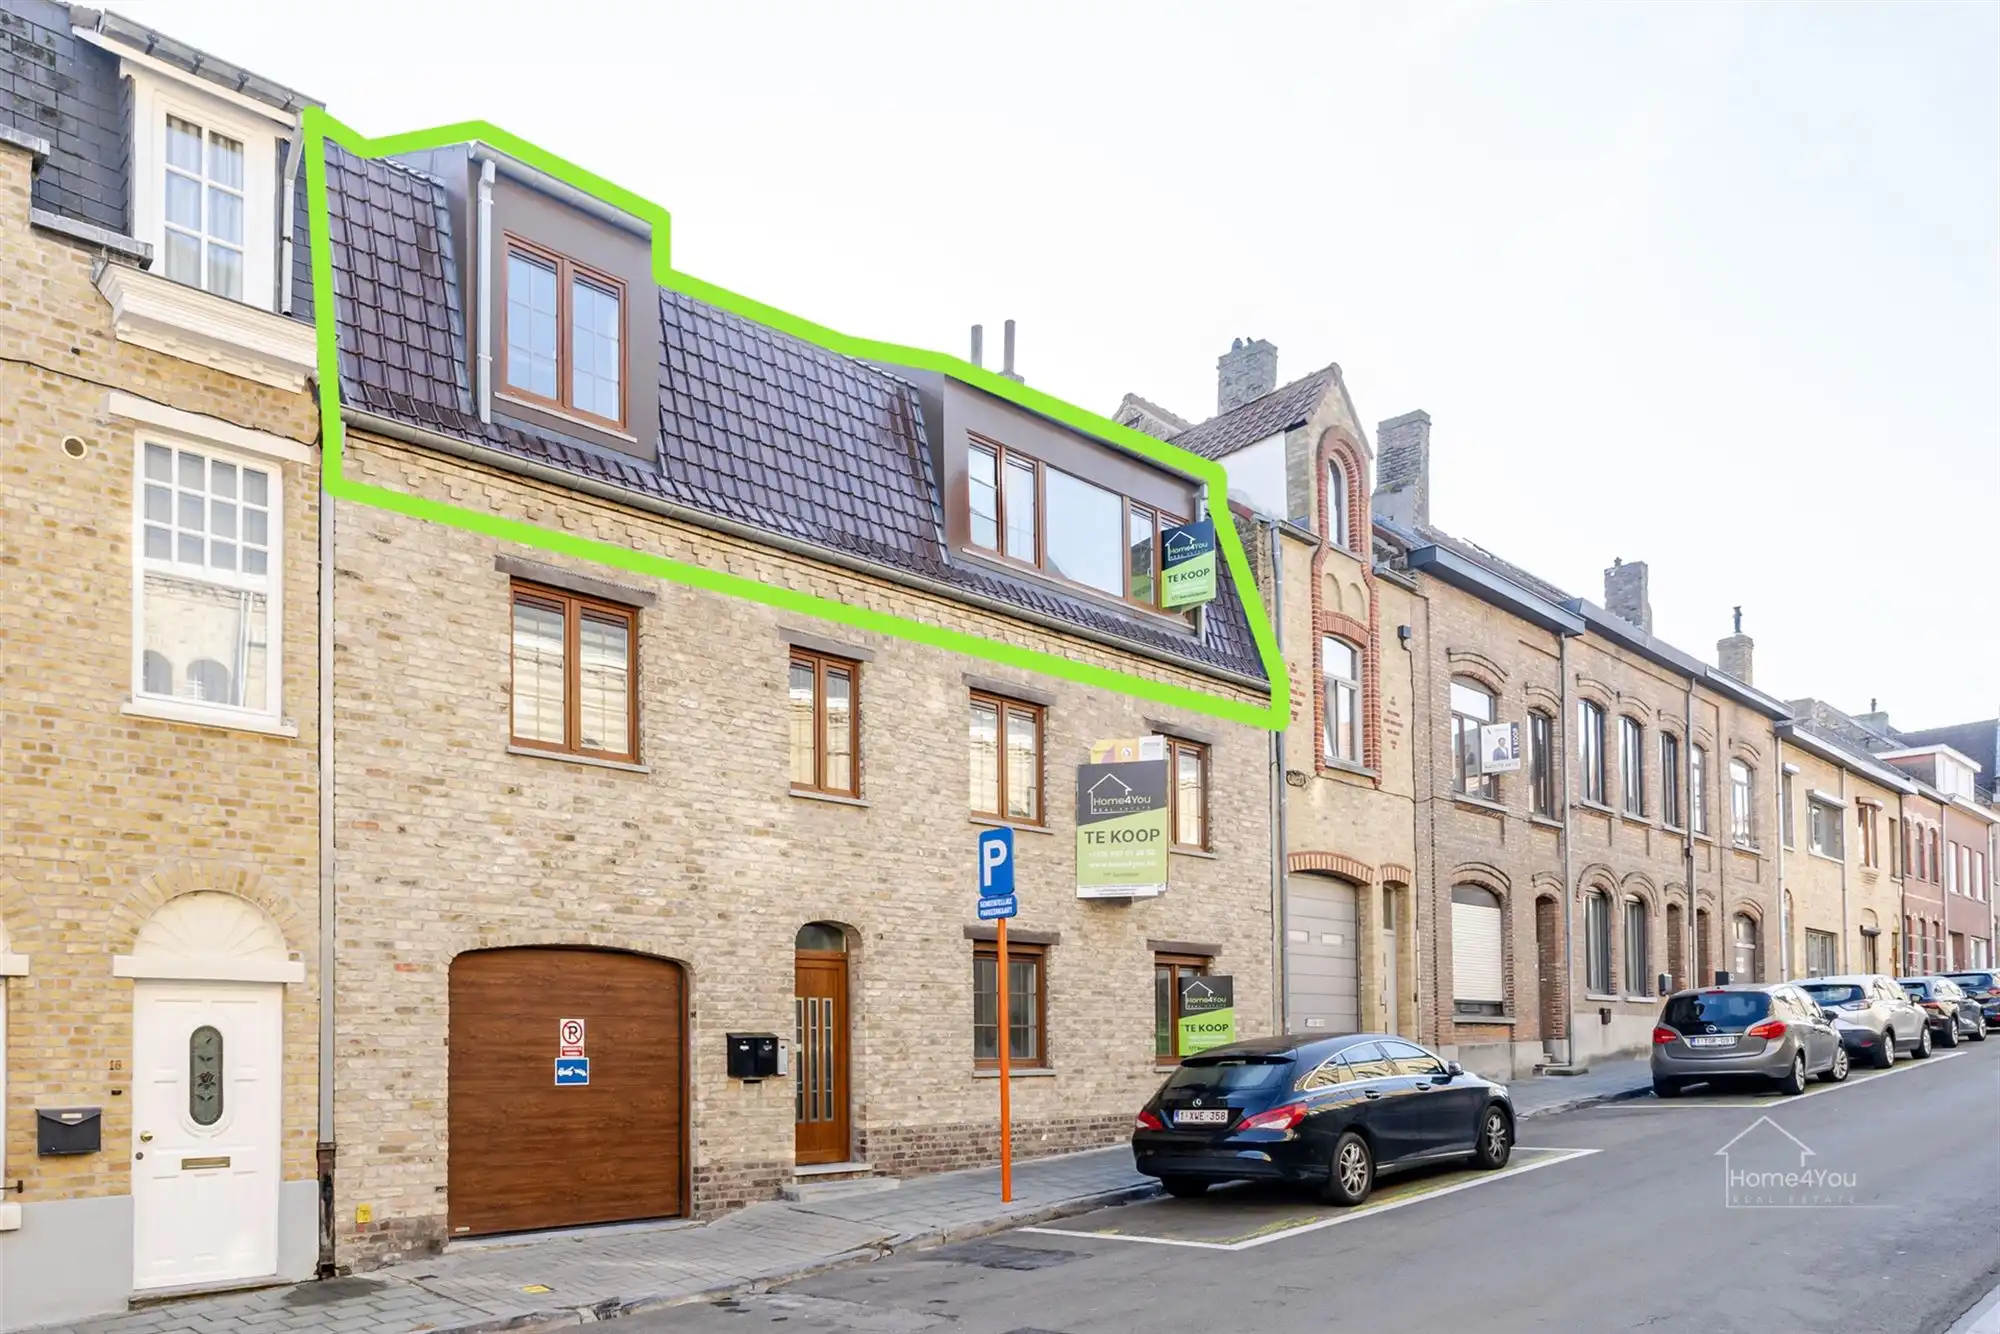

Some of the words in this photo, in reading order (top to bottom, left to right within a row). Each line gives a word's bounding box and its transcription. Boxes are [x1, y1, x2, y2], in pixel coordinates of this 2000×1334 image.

[1170, 541, 1208, 553] Home4You
[1168, 574, 1179, 583] TE
[1180, 568, 1210, 581] KOOP
[1093, 795, 1151, 806] Home4You
[1084, 830, 1106, 844] TE
[1110, 828, 1160, 844] KOOP
[983, 839, 1008, 887] P
[1187, 996, 1227, 1004] Home4You
[1185, 1024, 1197, 1032] TE
[1198, 1023, 1229, 1032] KOOP
